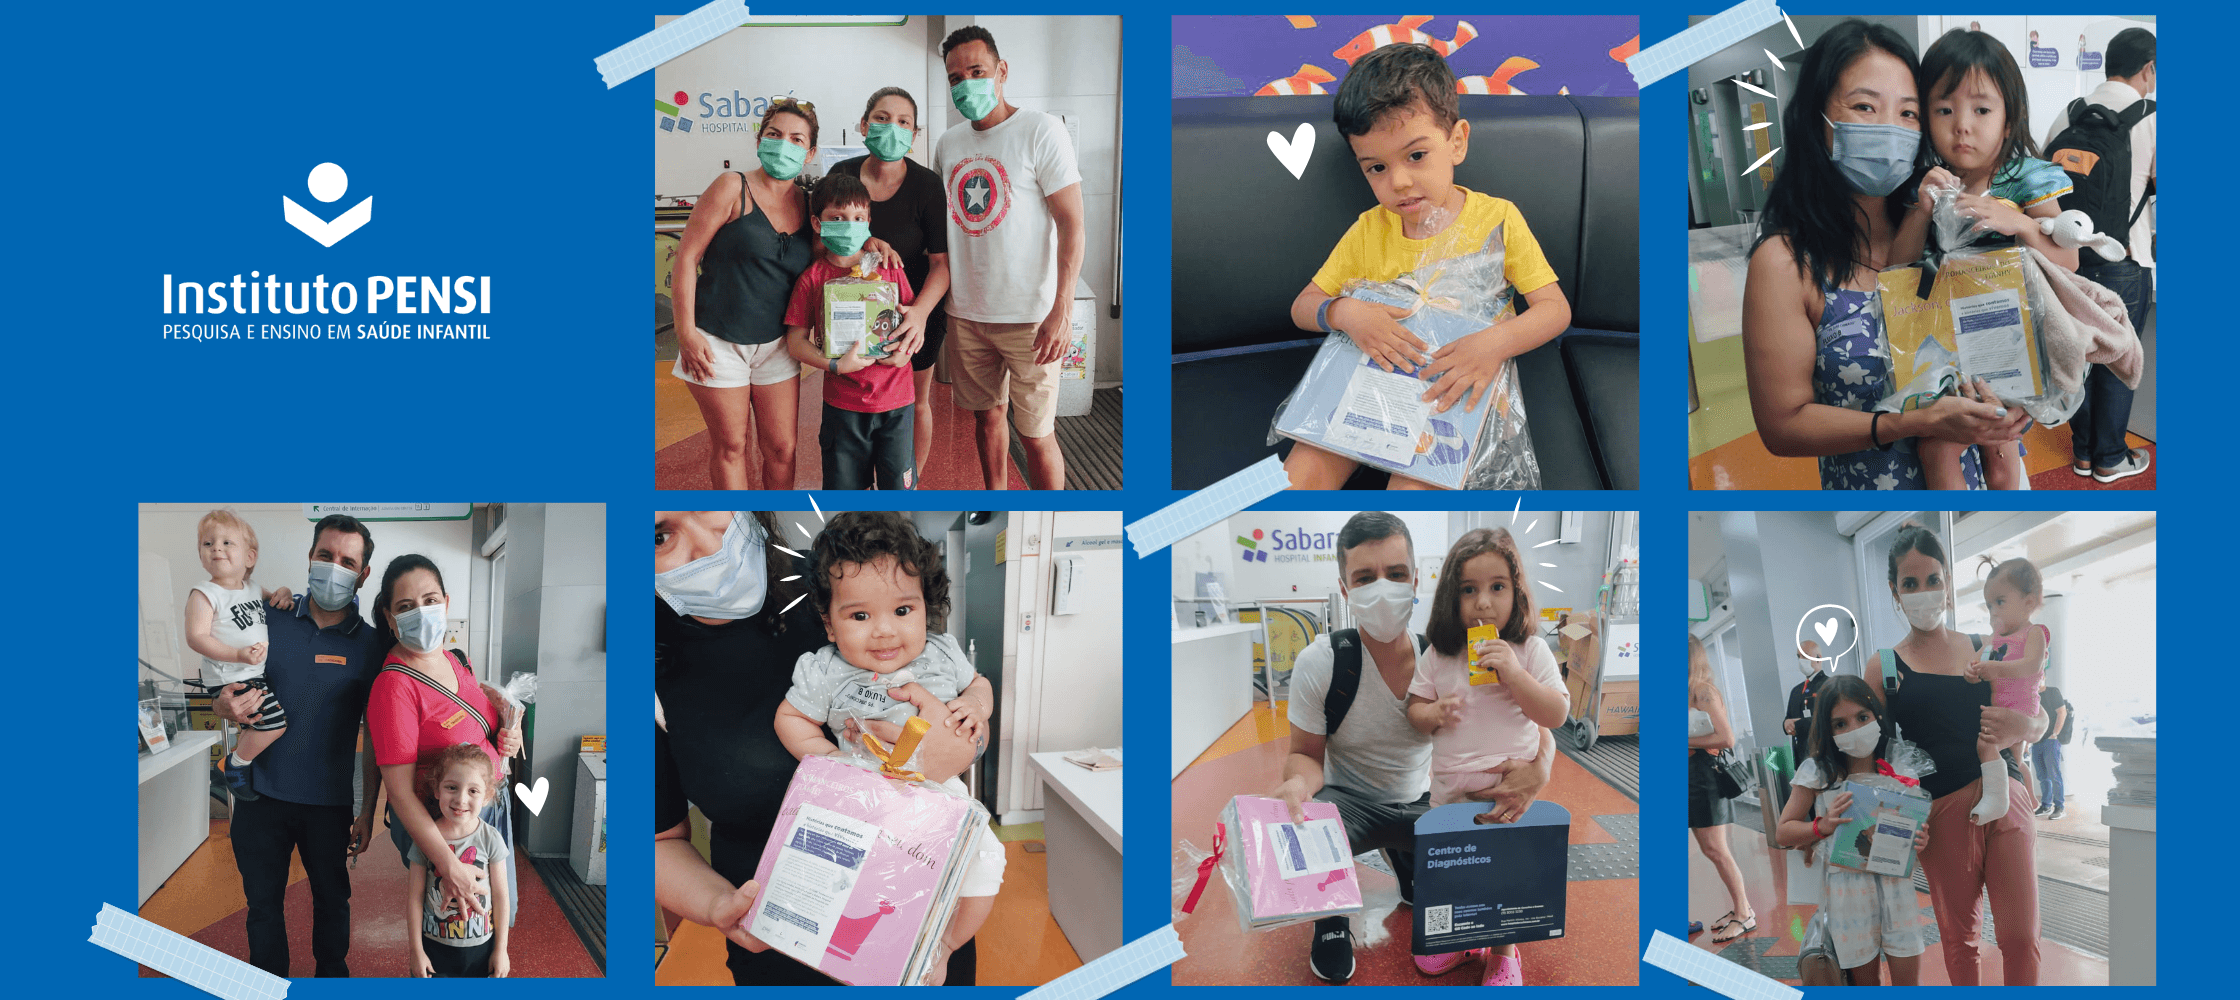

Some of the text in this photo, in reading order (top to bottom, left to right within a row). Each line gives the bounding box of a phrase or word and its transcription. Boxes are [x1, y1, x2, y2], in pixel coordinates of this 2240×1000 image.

[699, 89, 794, 118] Saba
[702, 123, 748, 133] HOSPITAL
[1274, 554, 1310, 563] HOSPITAL
[1427, 843, 1477, 856] Centro de
[1427, 855, 1492, 869] Diagnósticos
